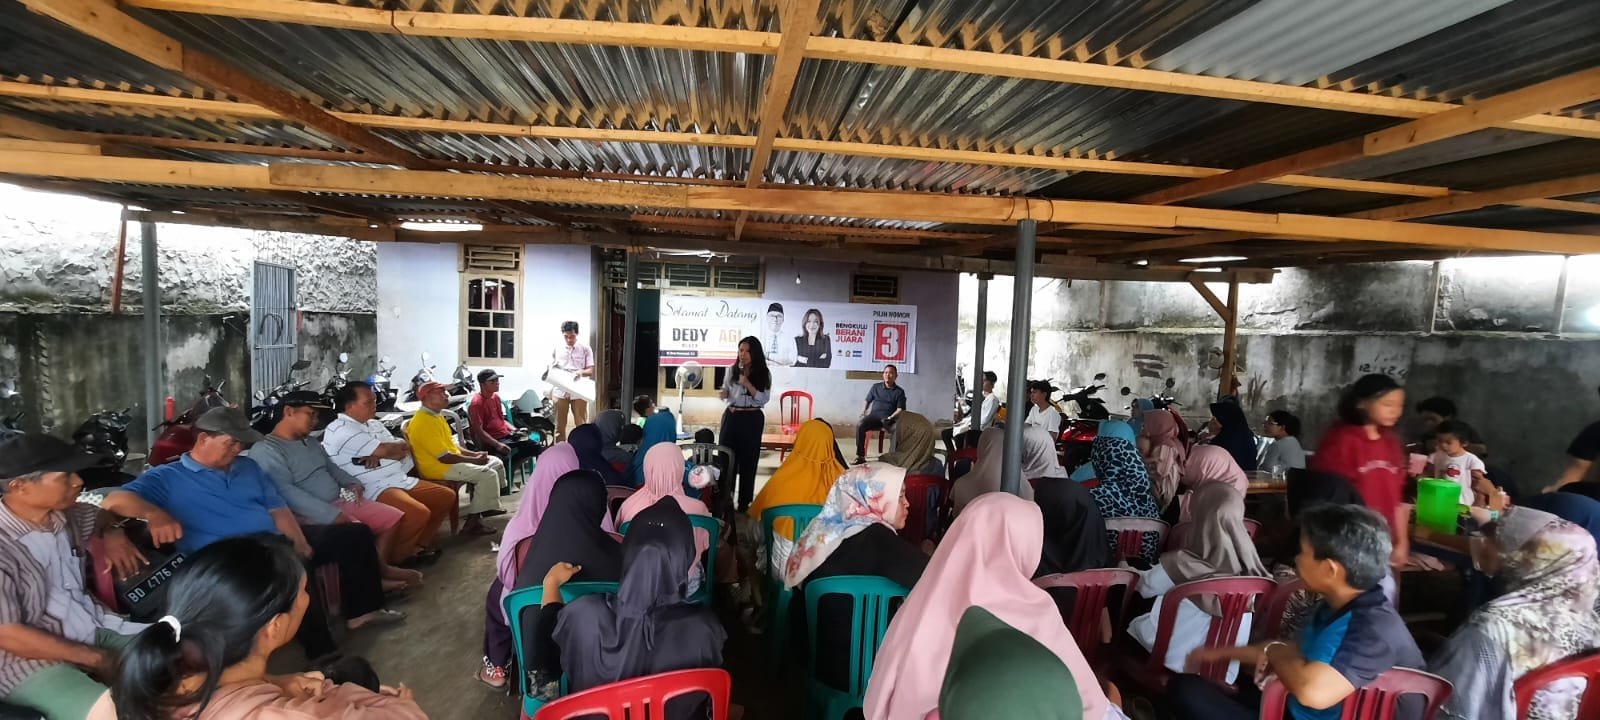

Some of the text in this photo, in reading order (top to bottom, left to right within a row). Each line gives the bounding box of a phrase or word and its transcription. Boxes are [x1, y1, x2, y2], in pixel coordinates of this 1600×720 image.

[661, 300, 758, 323] Selamat Datang
[873, 310, 888, 318] PILIH
[672, 328, 708, 341] DEDY
[882, 327, 899, 357] 3
[128, 588, 146, 602] BD
[147, 568, 172, 588] 4776
